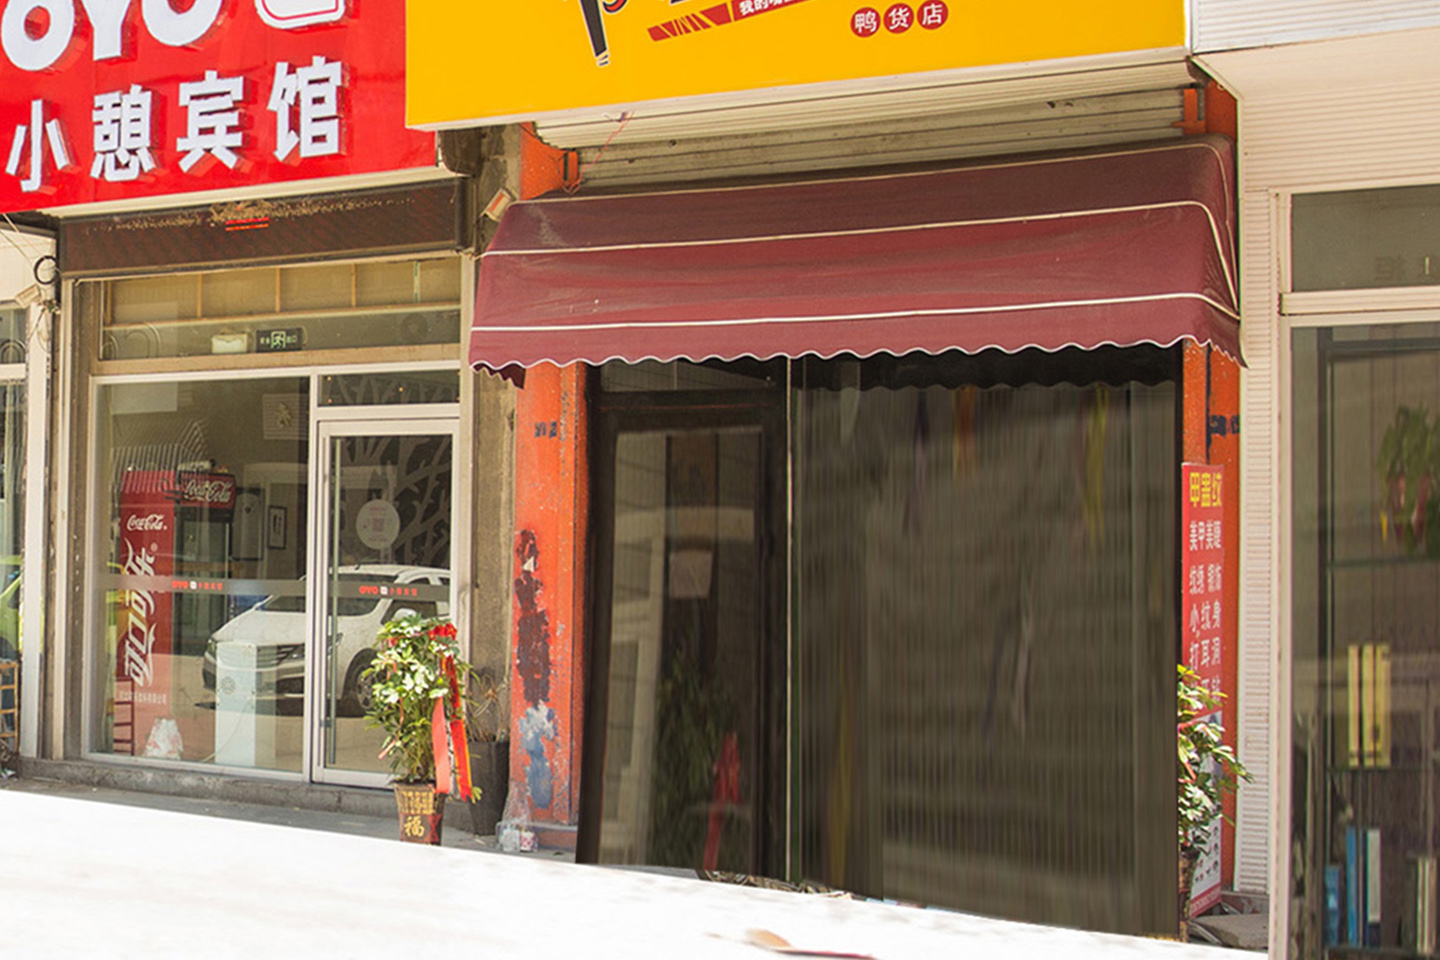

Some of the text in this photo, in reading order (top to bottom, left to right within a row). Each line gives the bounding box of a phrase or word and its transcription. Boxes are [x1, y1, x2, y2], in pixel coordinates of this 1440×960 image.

[854, 3, 944, 34] 鸭货店
[5, 54, 346, 193] 小憩宾馆
[403, 815, 426, 837] 福
